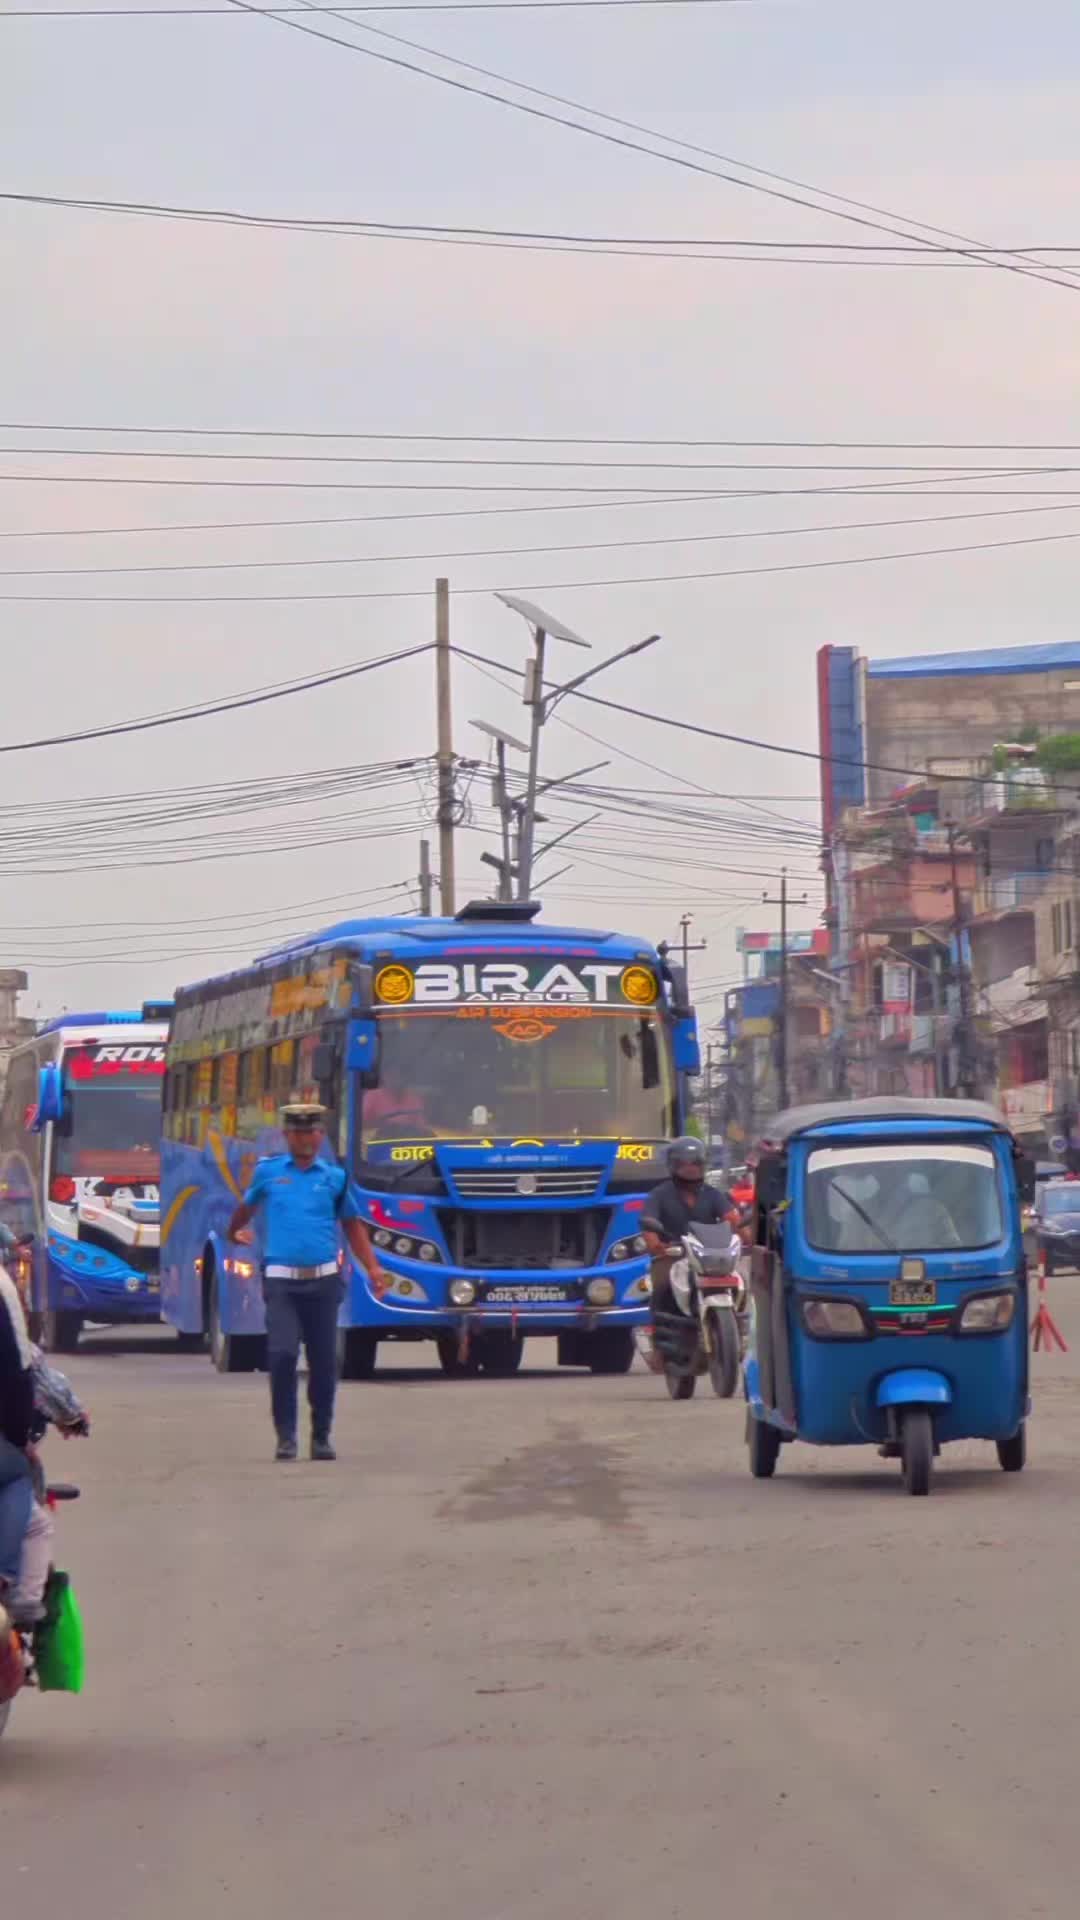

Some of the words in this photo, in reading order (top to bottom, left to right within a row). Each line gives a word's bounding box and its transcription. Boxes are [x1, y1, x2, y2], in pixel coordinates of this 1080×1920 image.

[415, 964, 623, 1001] BIRAT
[465, 993, 589, 1001] AIRBUS
[456, 1008, 485, 1018] AIR
[490, 1008, 592, 1018] SUSPENSION
[511, 1024, 538, 1035] AC
